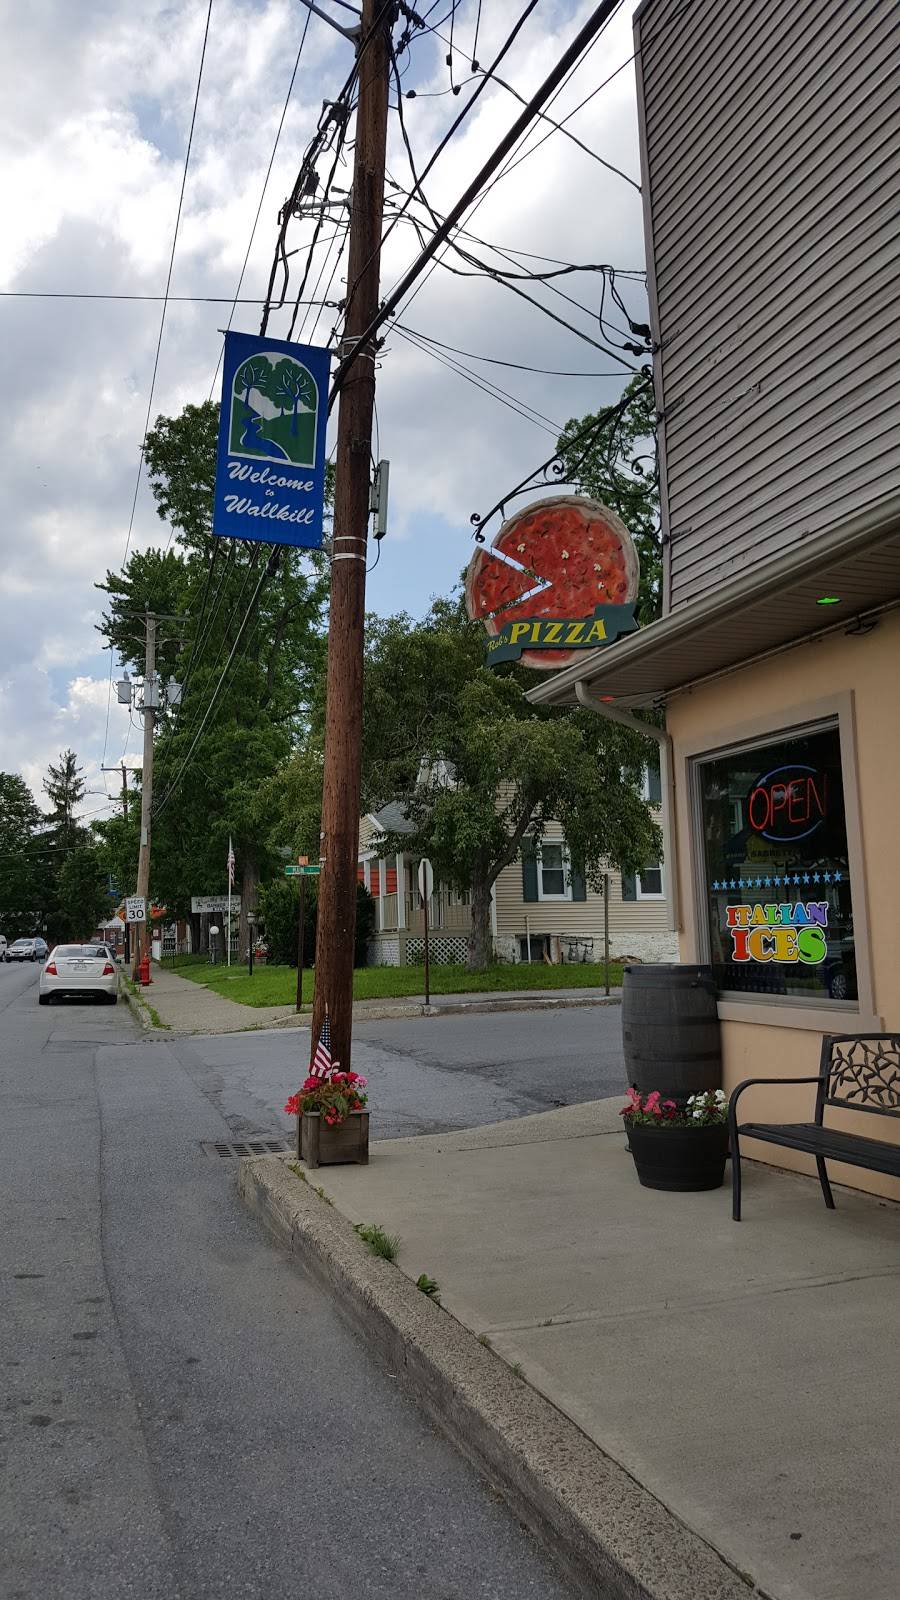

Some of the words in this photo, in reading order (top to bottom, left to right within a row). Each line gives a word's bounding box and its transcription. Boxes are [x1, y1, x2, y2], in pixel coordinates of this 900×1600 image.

[227, 462, 314, 491] Welcome
[265, 488, 275, 497] to
[224, 495, 314, 525] Wallkill
[508, 619, 608, 645] PIZZA
[750, 774, 827, 830] OPEN
[128, 909, 144, 919] 30
[726, 902, 828, 927] ITALIAN
[731, 926, 828, 964] ICES
